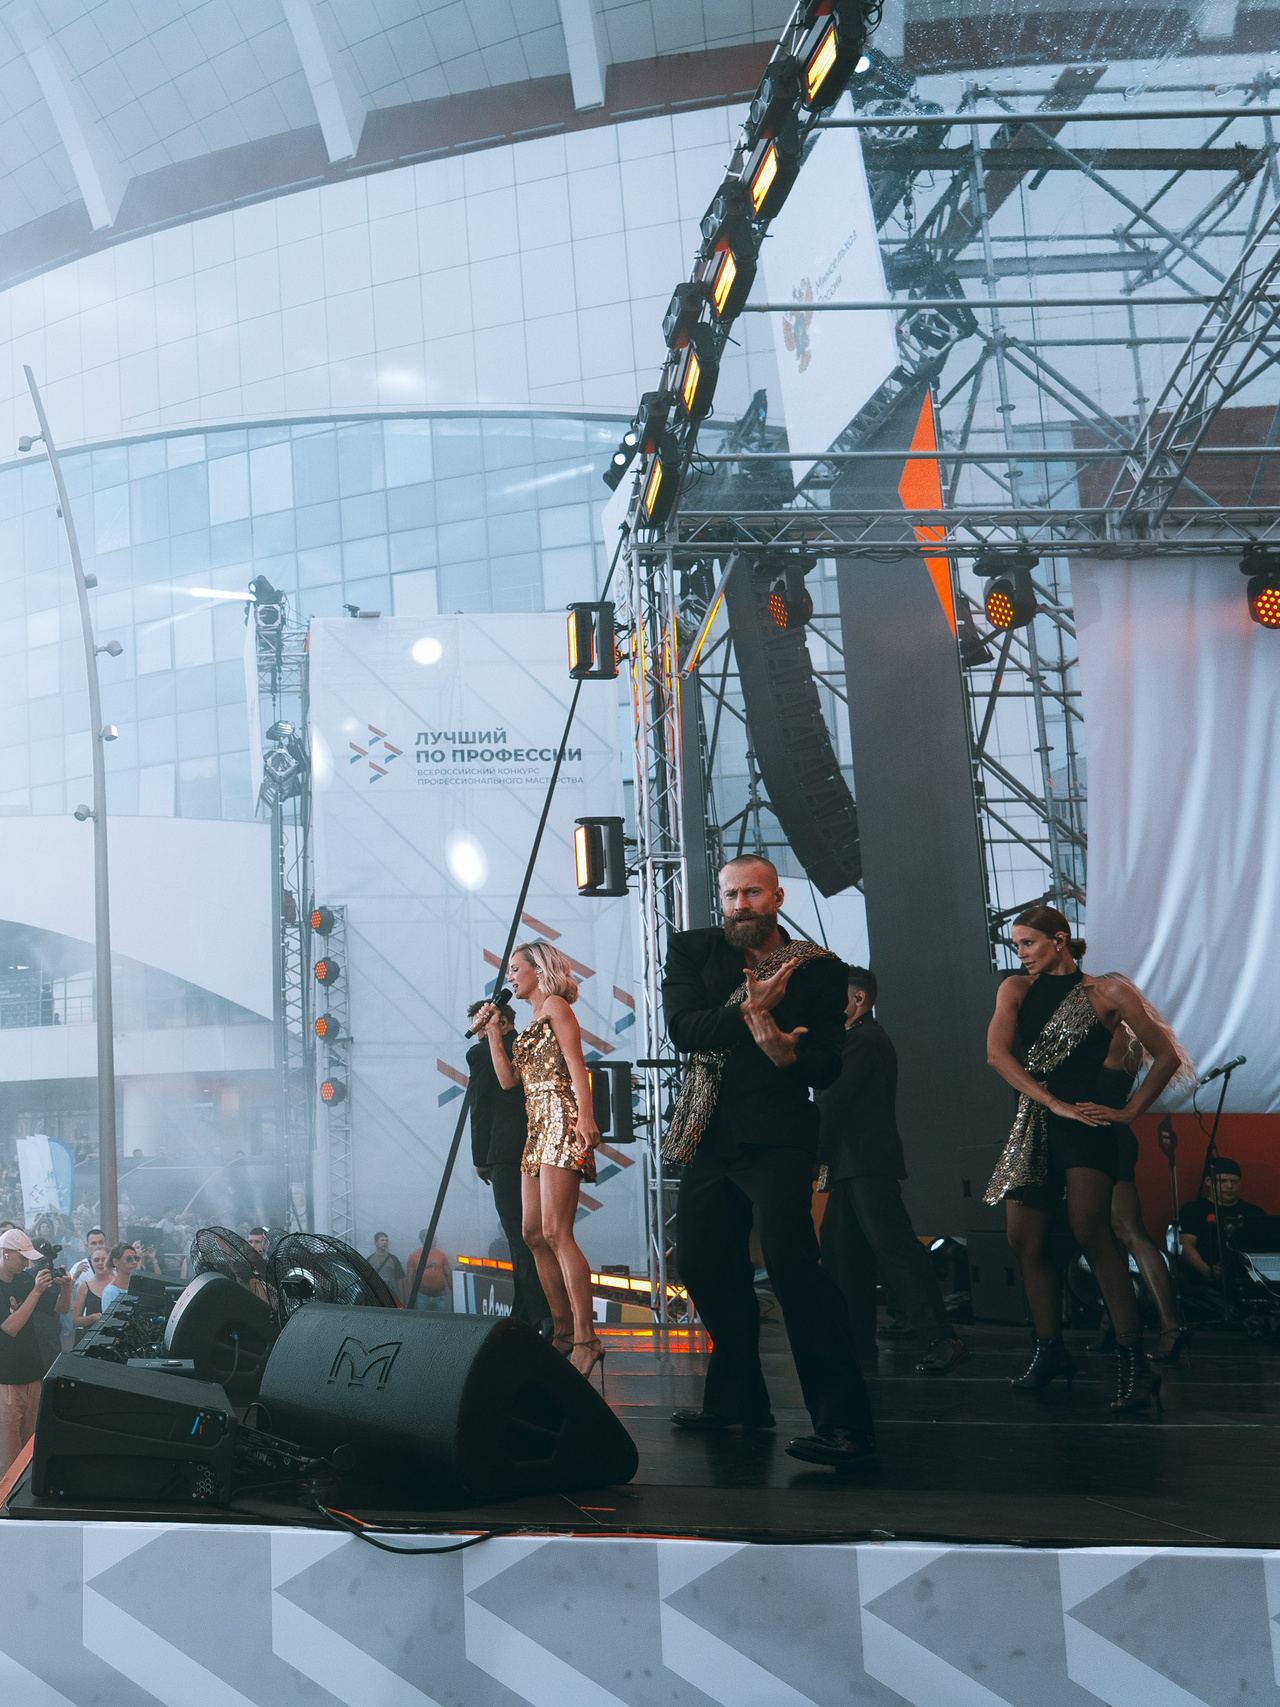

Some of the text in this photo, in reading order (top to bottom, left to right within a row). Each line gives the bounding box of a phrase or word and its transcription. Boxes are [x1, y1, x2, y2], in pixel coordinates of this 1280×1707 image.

[816, 229, 857, 295] Минсельхоз
[415, 727, 507, 746] ЛУЧШИЙ
[416, 748, 582, 763] ПО ПРОФЕССИИ
[417, 767, 540, 776] ВСЕРОССИЙСКИЙ КОНКУРС
[417, 776, 584, 786] ПРОФЕССИОНАЛЬНОГО МАСТРСТВА
